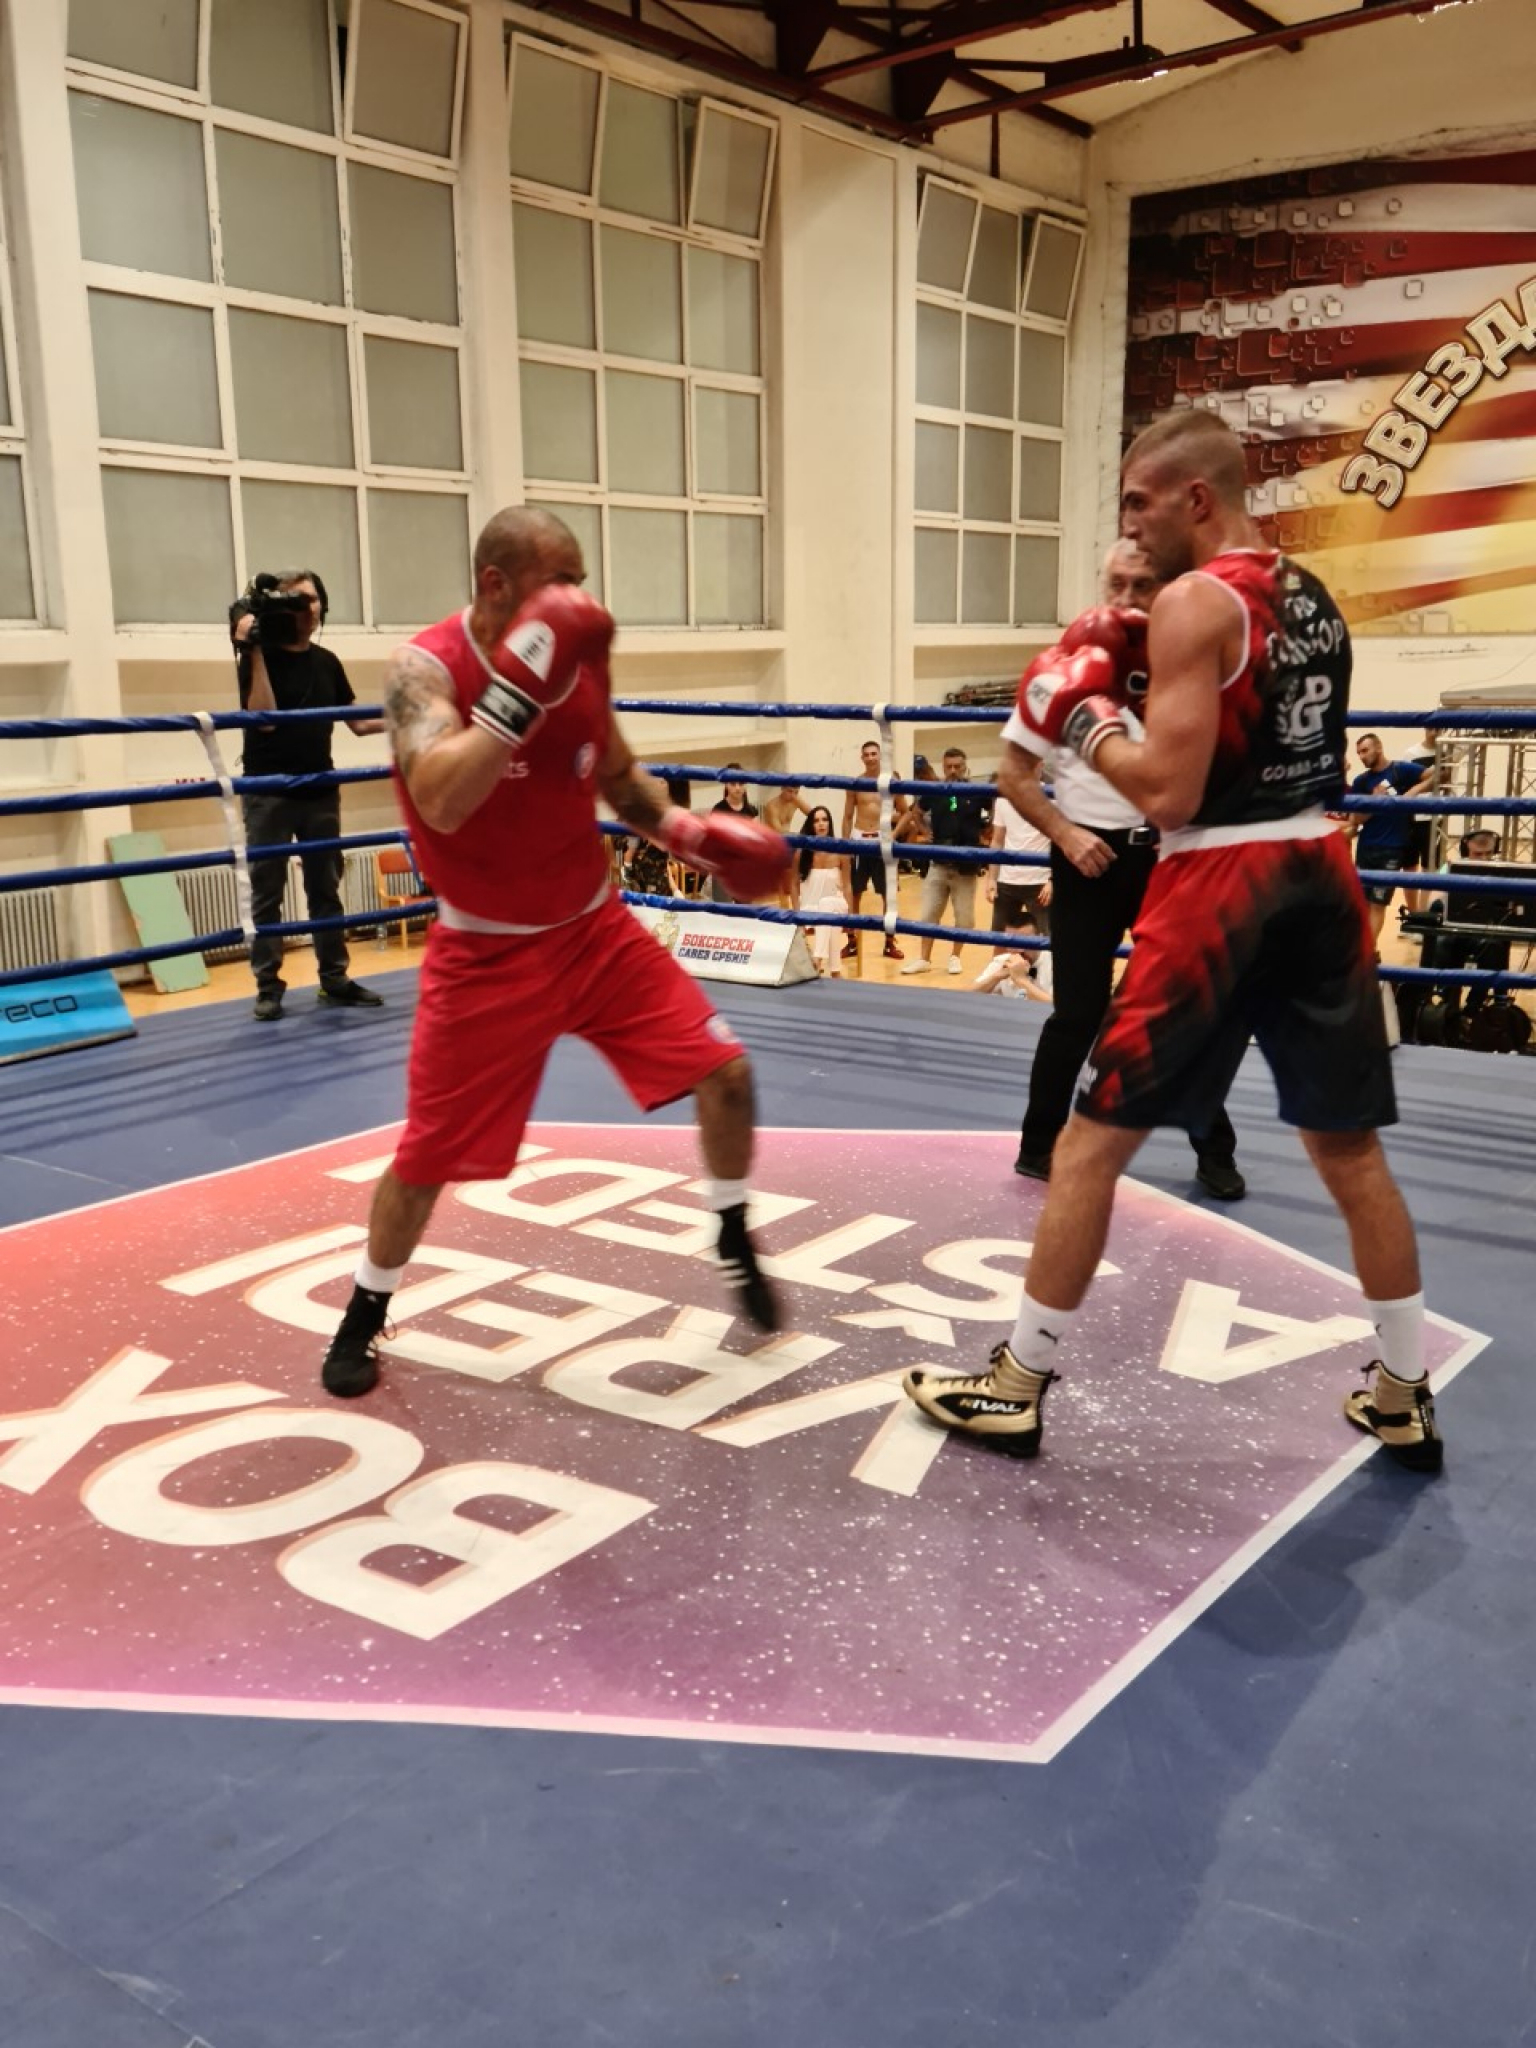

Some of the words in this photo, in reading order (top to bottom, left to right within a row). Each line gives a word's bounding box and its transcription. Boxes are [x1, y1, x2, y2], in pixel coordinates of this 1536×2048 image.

[682, 933, 755, 953] БОКСЕРСКИ
[0, 994, 78, 1024] eco
[960, 1397, 1022, 1413] RIVAL
[0, 1346, 660, 1641] BOX
